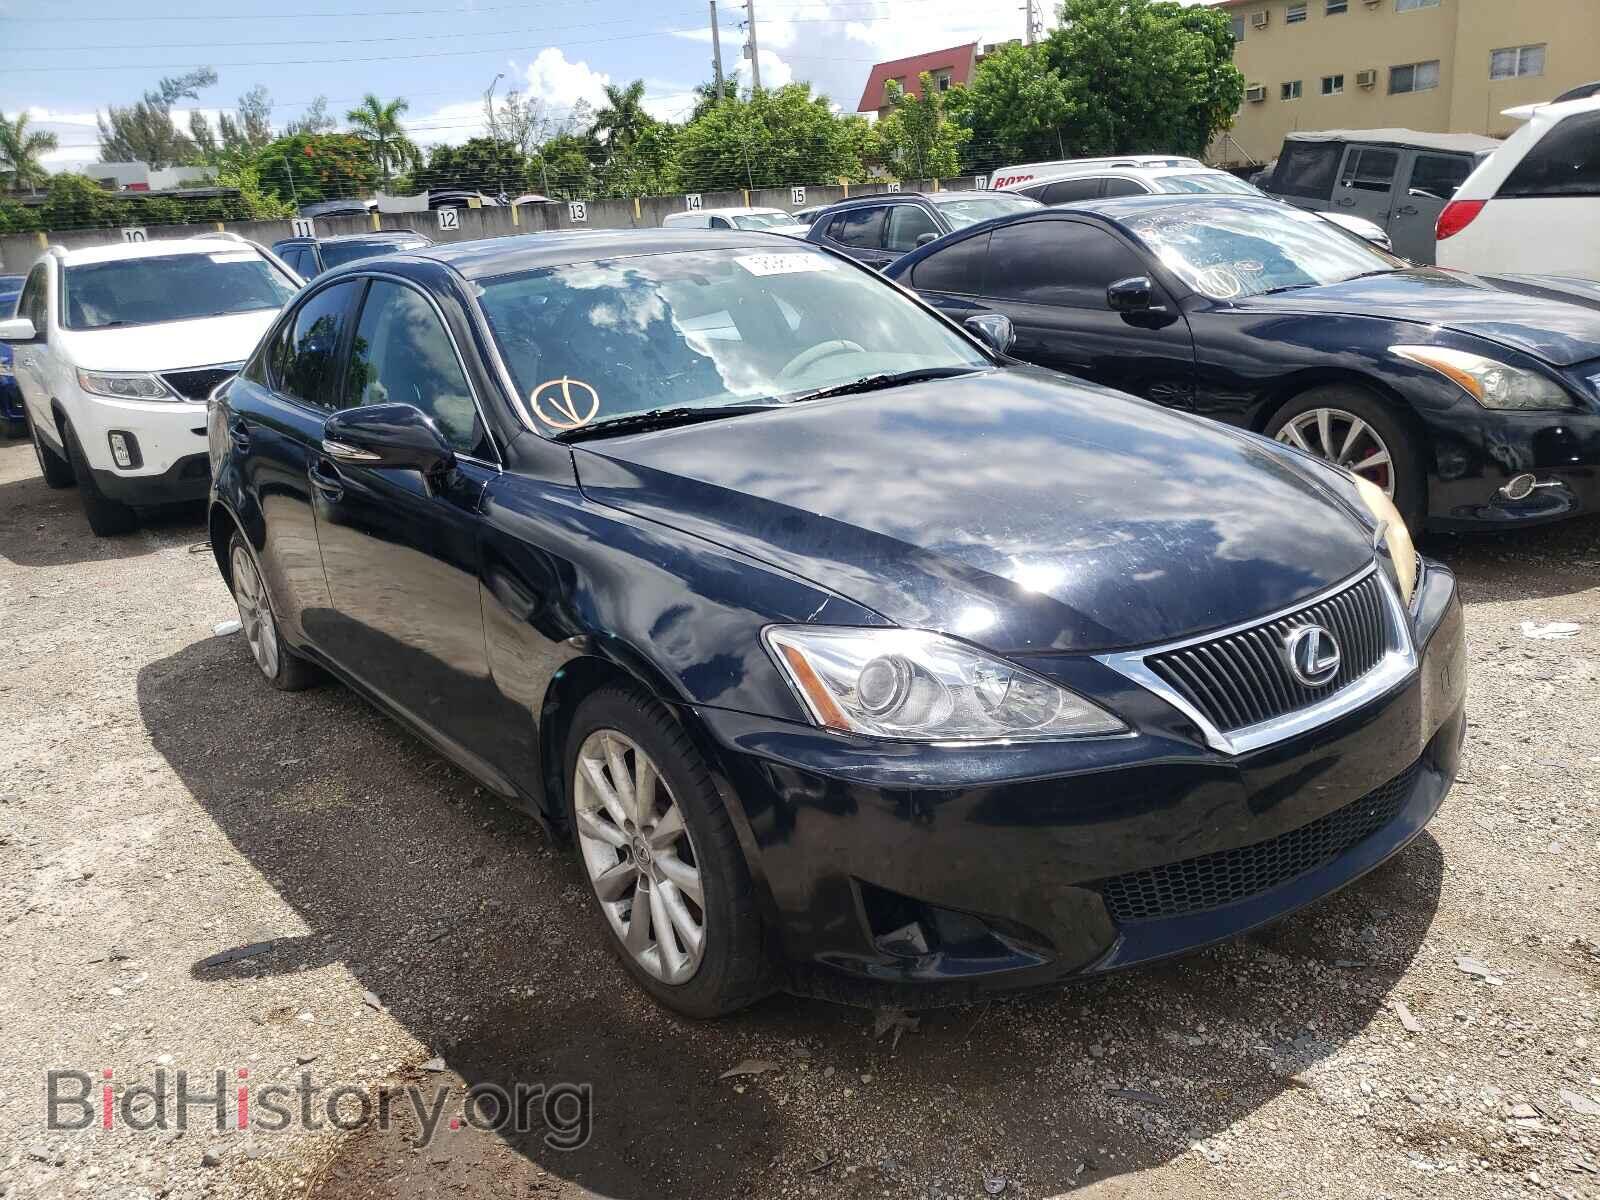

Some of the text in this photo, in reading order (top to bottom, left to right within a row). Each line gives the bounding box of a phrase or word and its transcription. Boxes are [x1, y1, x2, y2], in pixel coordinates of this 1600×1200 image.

[976, 178, 986, 189] 17
[793, 189, 804, 202] 15
[688, 196, 700, 210] 14
[571, 204, 585, 219] 13
[441, 212, 457, 228] 12
[125, 231, 145, 242] 10
[295, 222, 311, 237] 11
